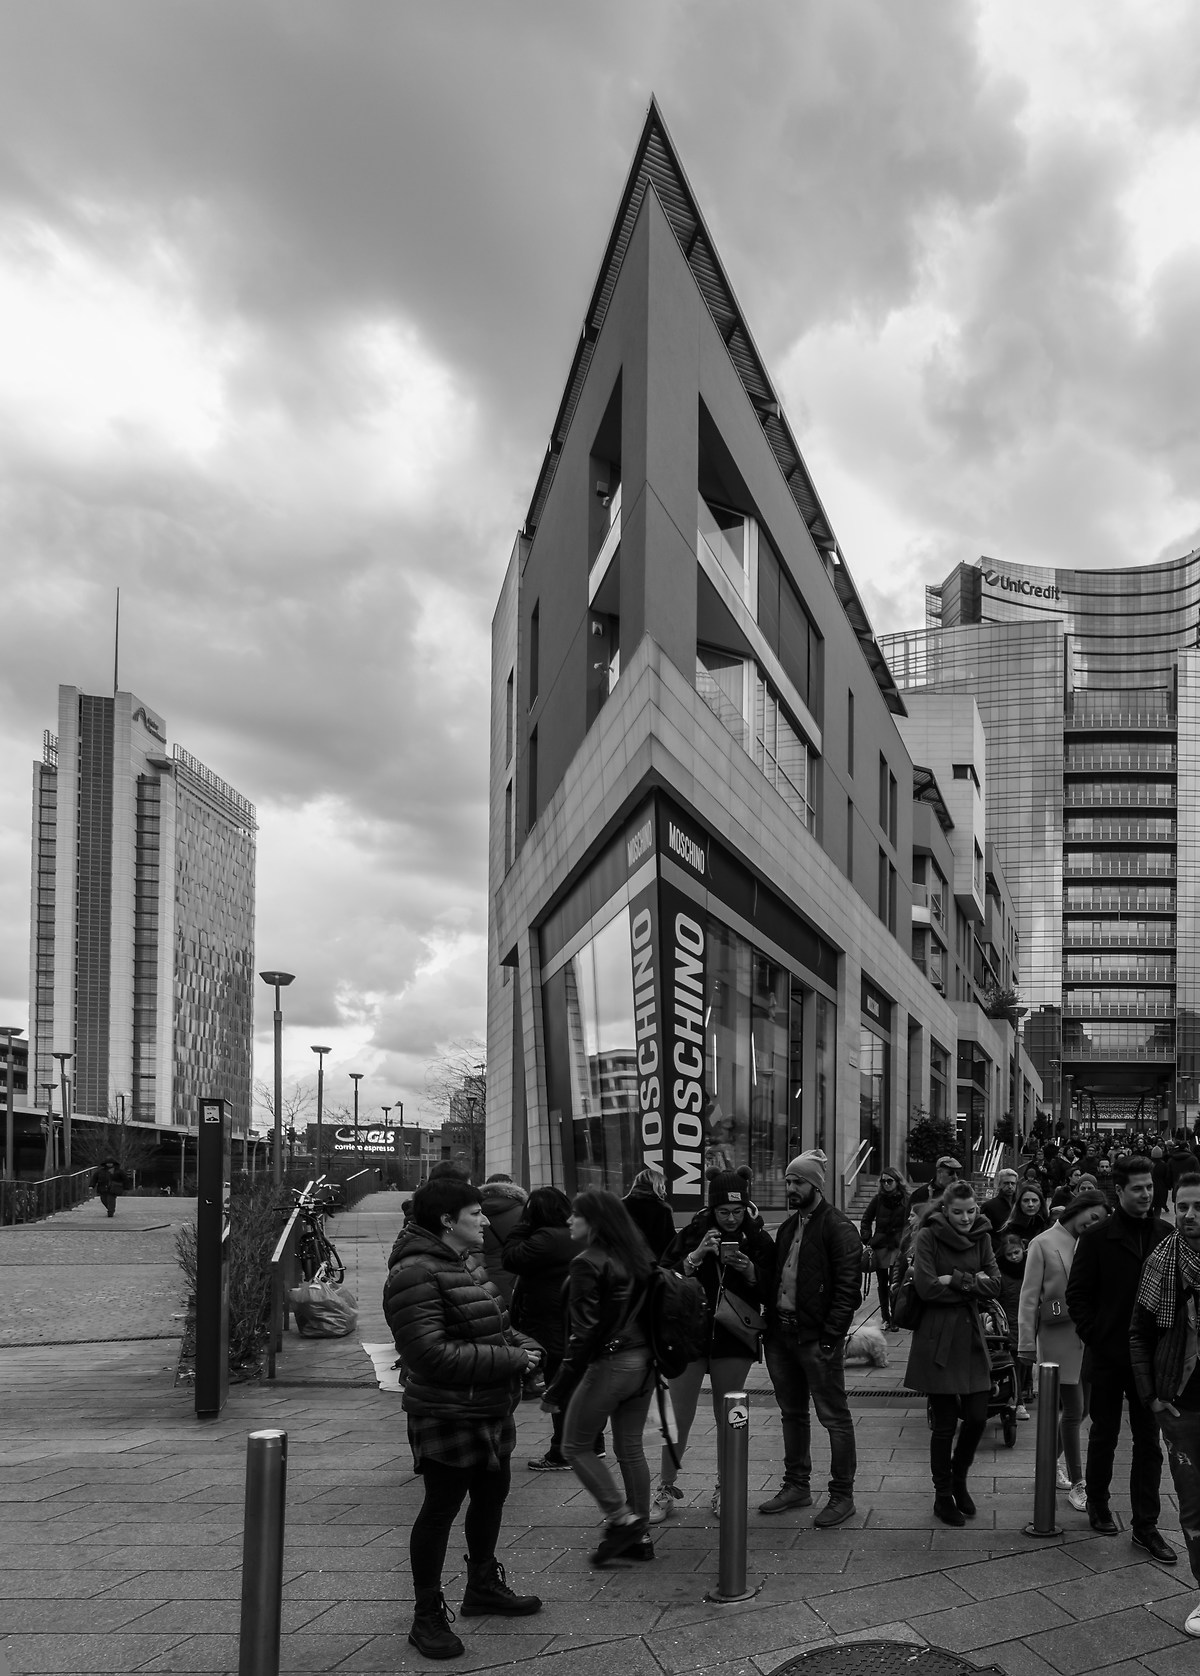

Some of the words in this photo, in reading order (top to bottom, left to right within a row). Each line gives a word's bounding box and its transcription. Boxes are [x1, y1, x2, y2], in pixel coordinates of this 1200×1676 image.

[1001, 575, 1060, 600] UniCredit
[627, 819, 652, 867] MOSCHINO
[669, 821, 704, 875] MOSCHINO
[672, 912, 704, 1195] MOSCHINO
[367, 1130, 395, 1144] GLS
